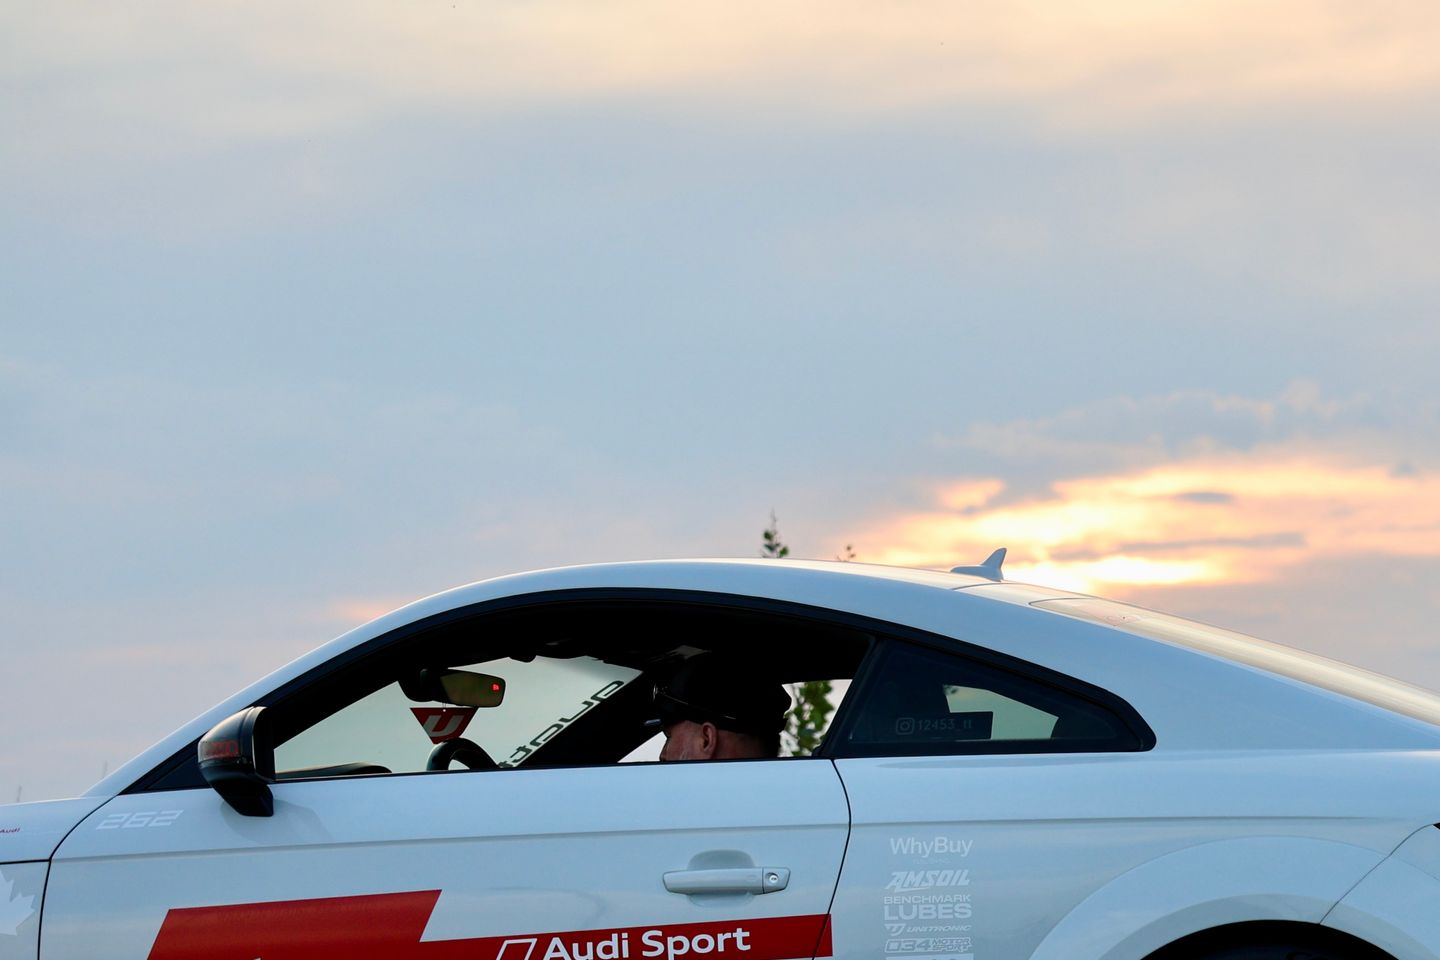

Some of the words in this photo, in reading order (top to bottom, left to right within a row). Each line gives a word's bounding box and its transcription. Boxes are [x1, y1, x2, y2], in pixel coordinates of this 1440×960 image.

[890, 836, 973, 859] WhyBuy
[884, 869, 971, 893] AMSOIL
[883, 894, 971, 905] BENCHMARK
[884, 903, 972, 921] LUBES
